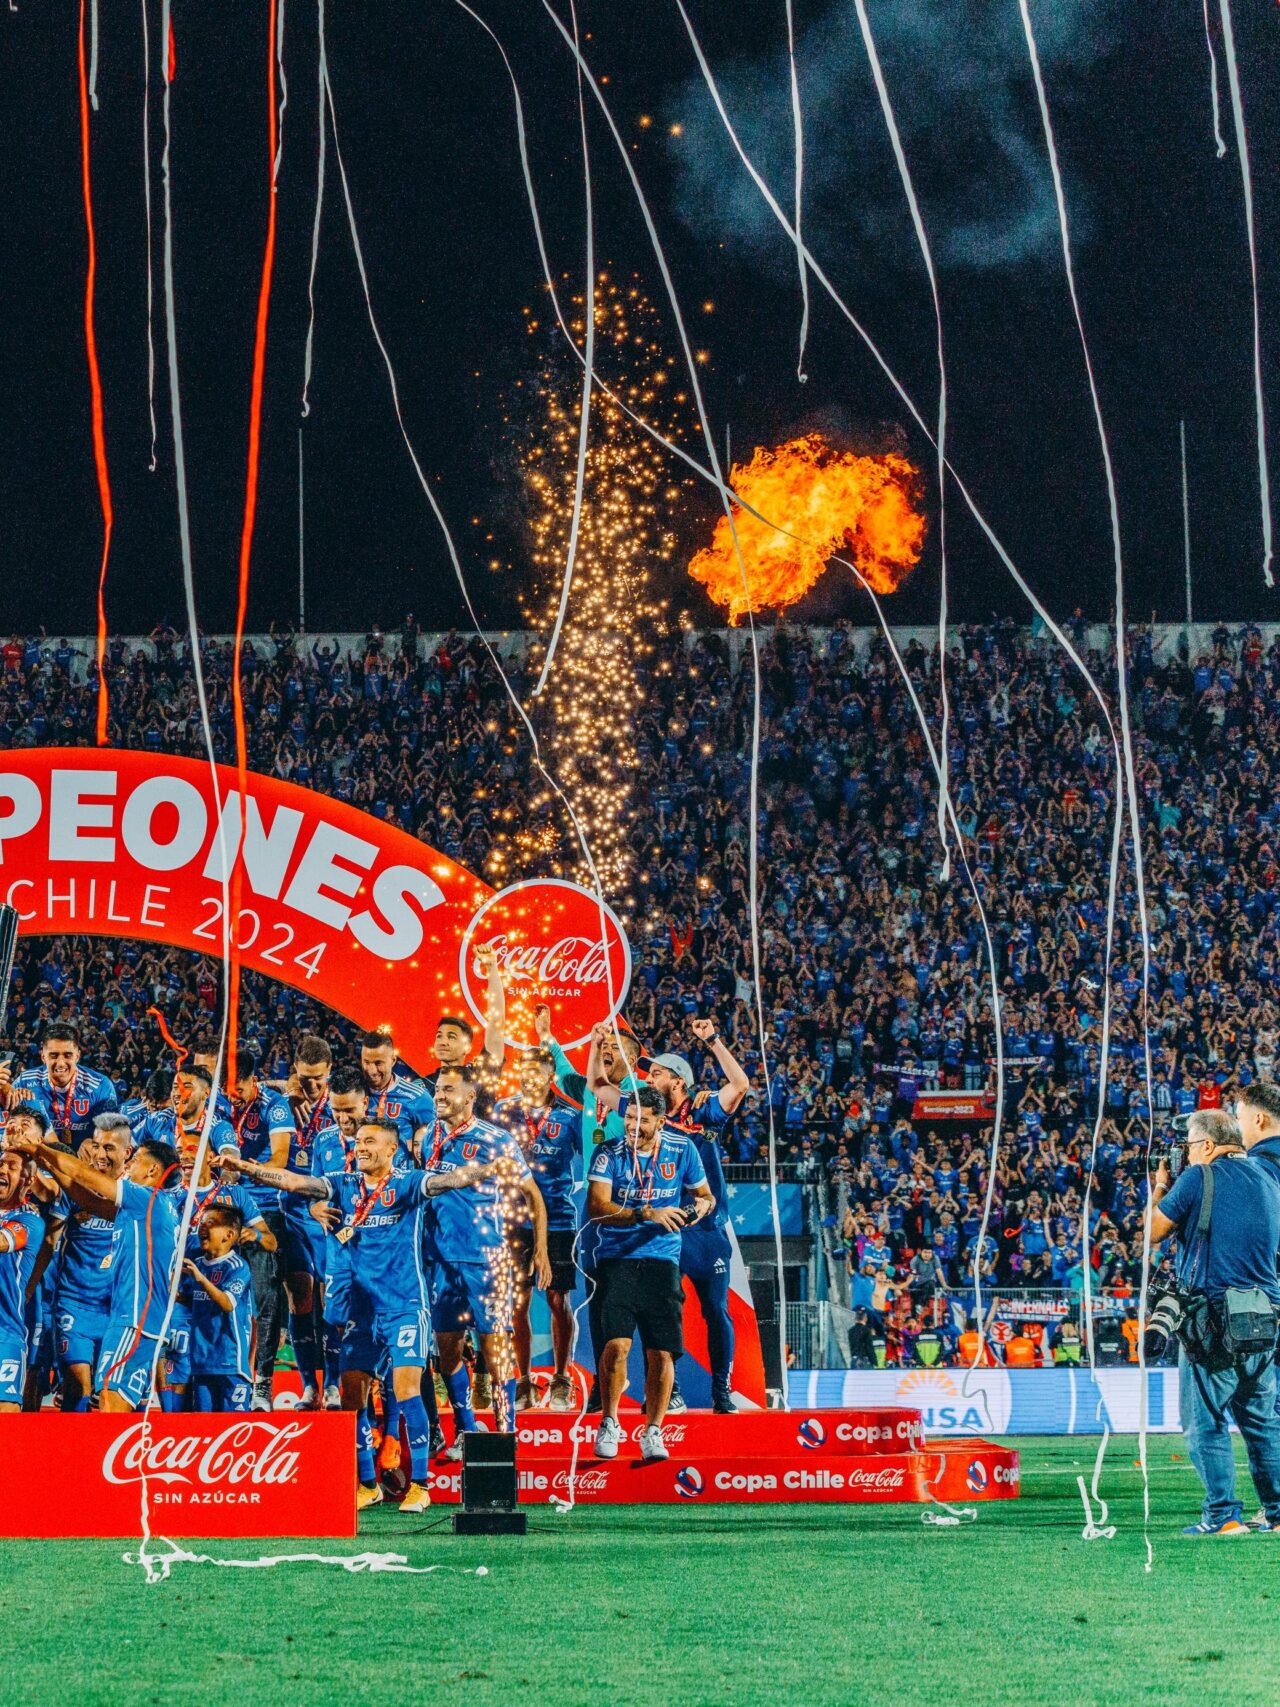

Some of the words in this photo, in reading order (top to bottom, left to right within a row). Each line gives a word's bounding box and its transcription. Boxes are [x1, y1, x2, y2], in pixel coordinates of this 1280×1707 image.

[6, 878, 171, 928] CHILE
[192, 897, 328, 980] 2024
[473, 934, 618, 983] Coca-Cola
[508, 986, 528, 995] SIN
[532, 986, 581, 997] AZÚCAR
[836, 1422, 893, 1444] Copa
[102, 1421, 313, 1485] Coca-Cola
[714, 1471, 777, 1492] Copa
[783, 1470, 845, 1489] Chile
[848, 1468, 907, 1487] Coca-Cola
[153, 1492, 183, 1504] SIN
[190, 1490, 261, 1504] AZÚCAR
